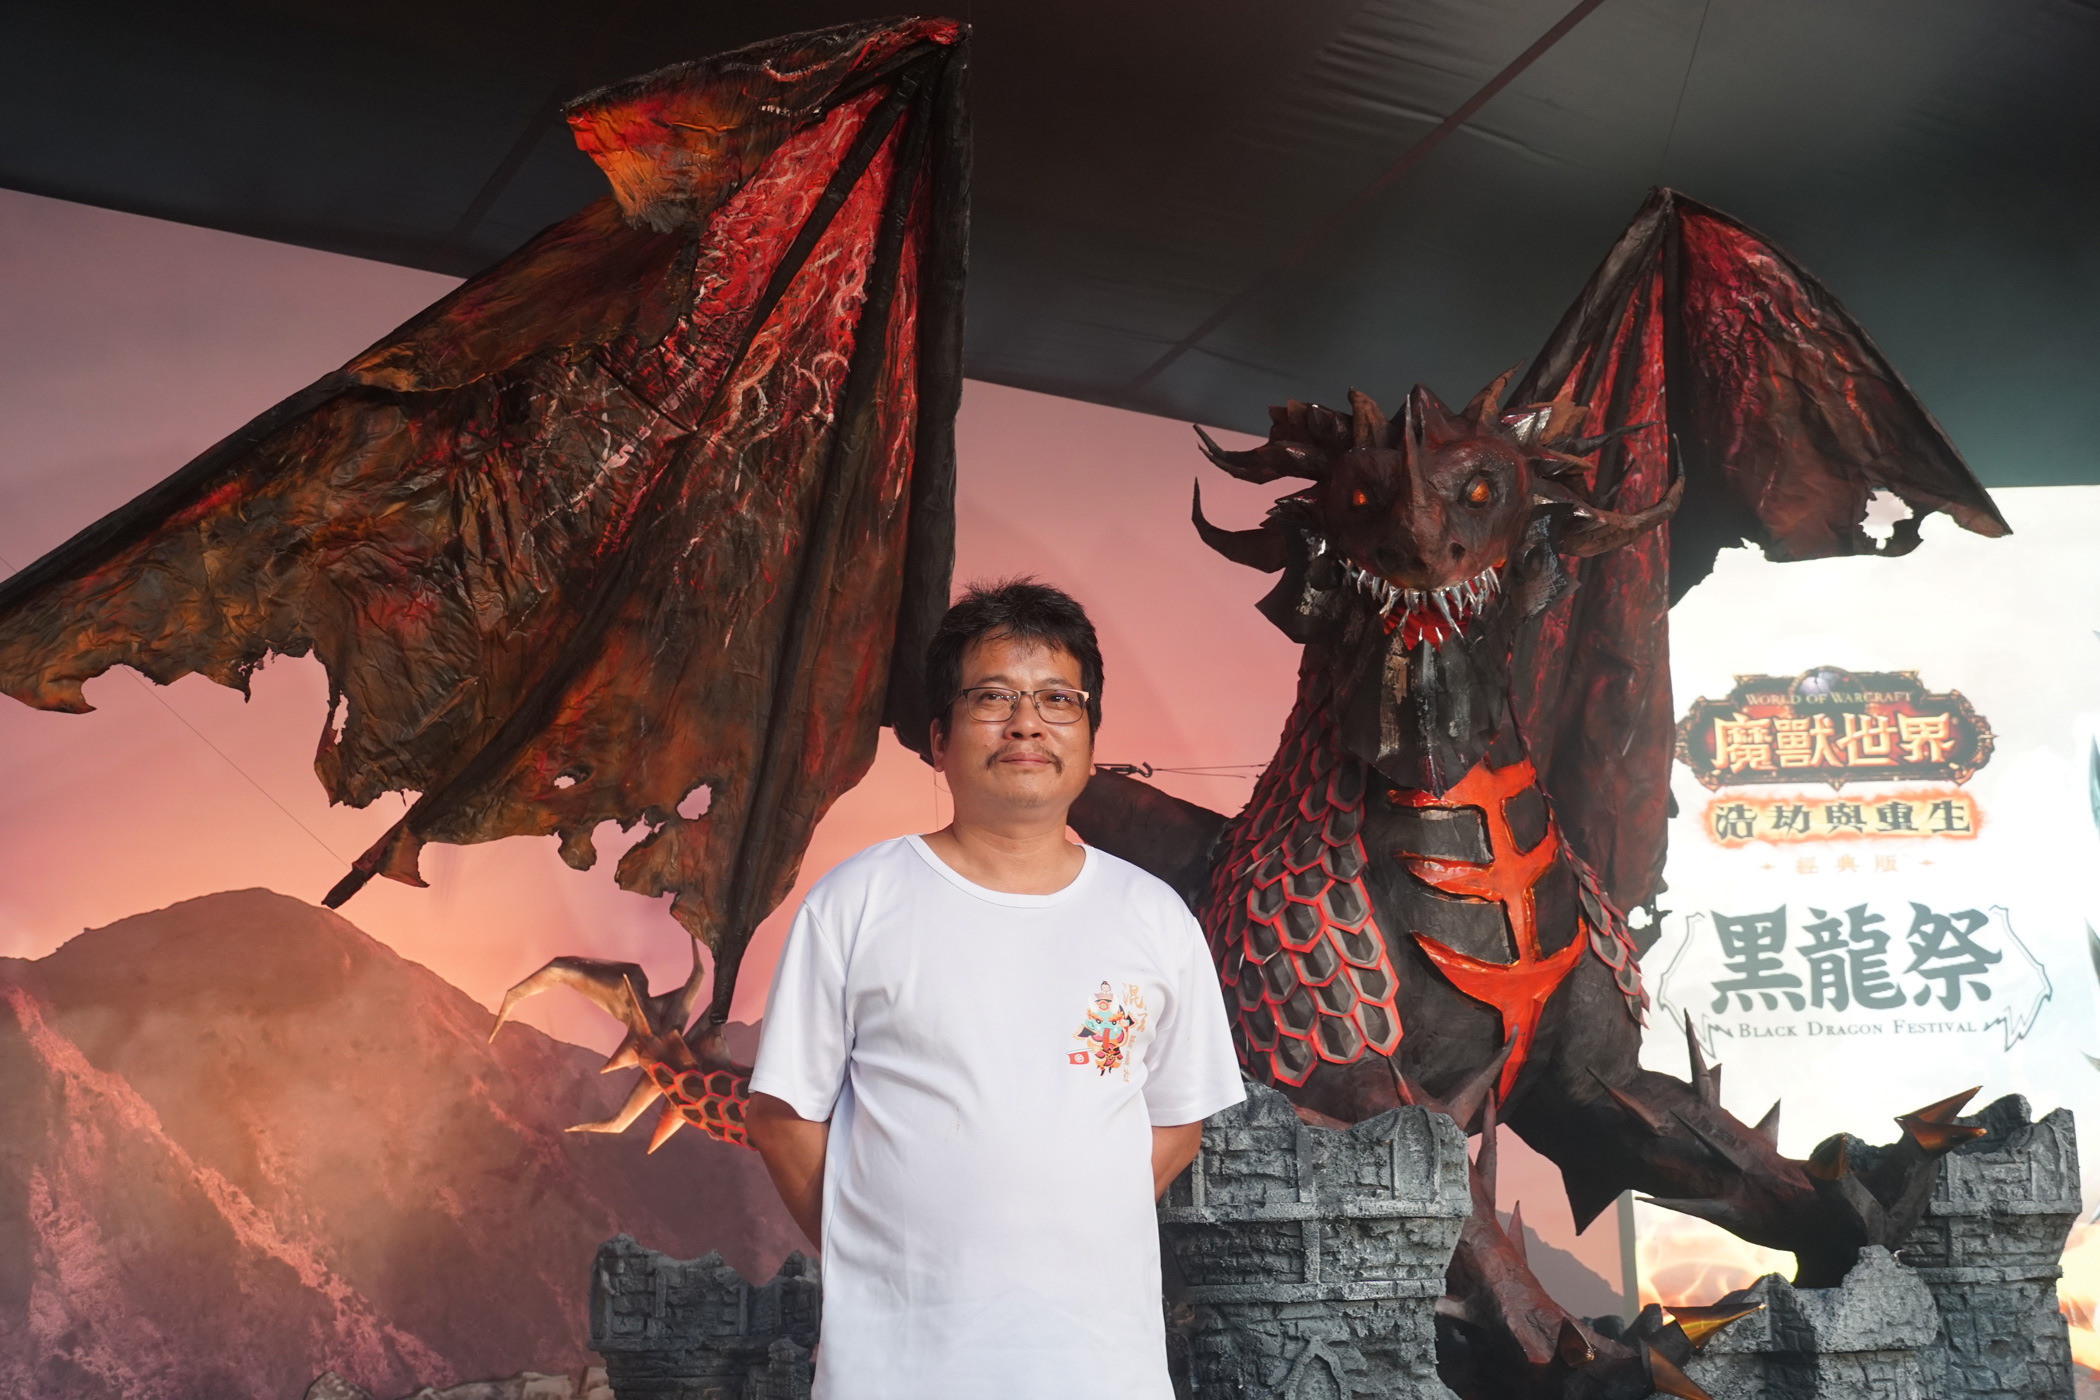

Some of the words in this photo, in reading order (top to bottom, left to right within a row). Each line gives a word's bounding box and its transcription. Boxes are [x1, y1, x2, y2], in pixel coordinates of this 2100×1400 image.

[1745, 693, 1801, 706] WORLD
[1805, 693, 1828, 705] OF
[1830, 691, 1913, 704] WARCRAFT
[1711, 711, 1957, 773] 魔獸世界
[1715, 799, 1972, 841] 浩劫與重生
[1794, 854, 1901, 875] 經典版
[1709, 900, 2003, 1014] 黑龍祭
[1739, 1022, 1799, 1038] BLACK
[1807, 1020, 1883, 1036] DRAGON
[1893, 1018, 1978, 1034] FESTIVAL
